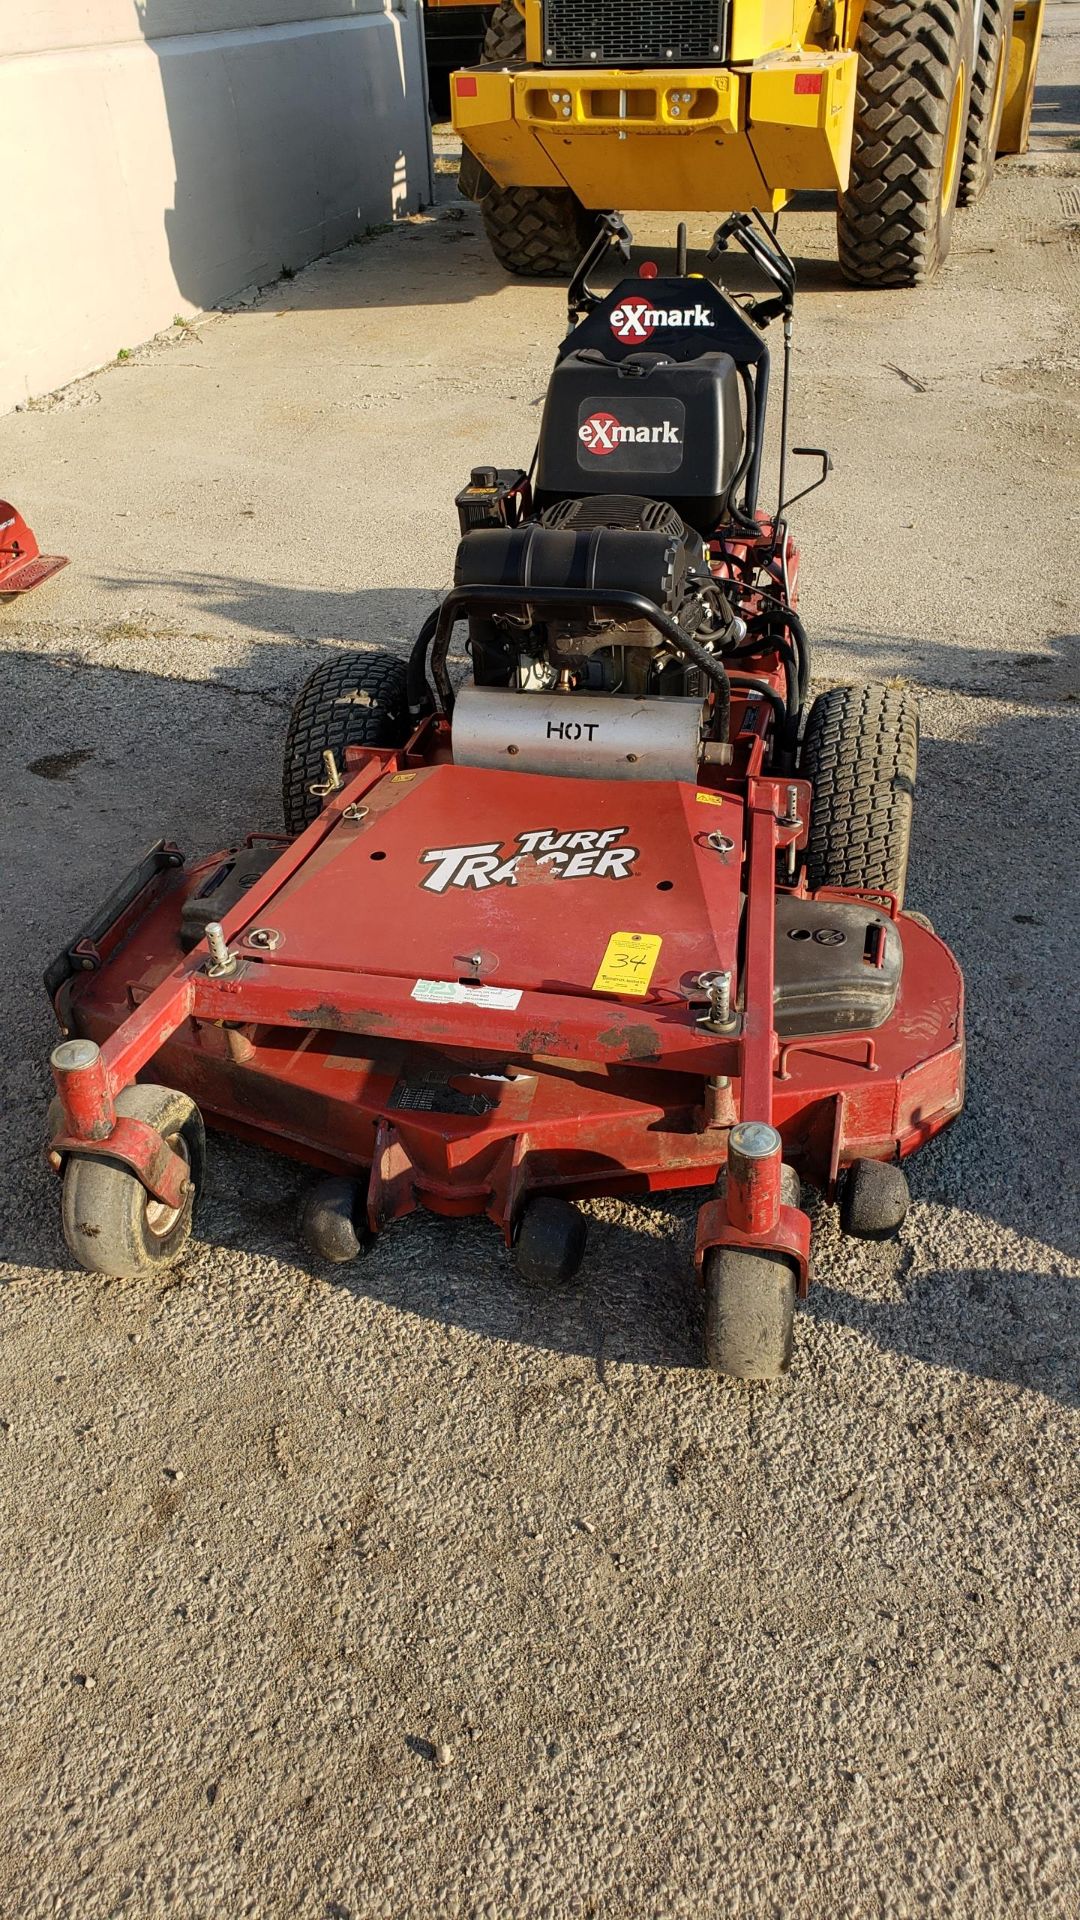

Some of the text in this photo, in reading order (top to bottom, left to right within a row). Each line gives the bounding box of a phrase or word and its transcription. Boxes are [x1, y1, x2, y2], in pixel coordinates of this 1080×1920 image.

[546, 721, 600, 742] HOT
[518, 828, 625, 853] TURF
[609, 953, 647, 973] 34
